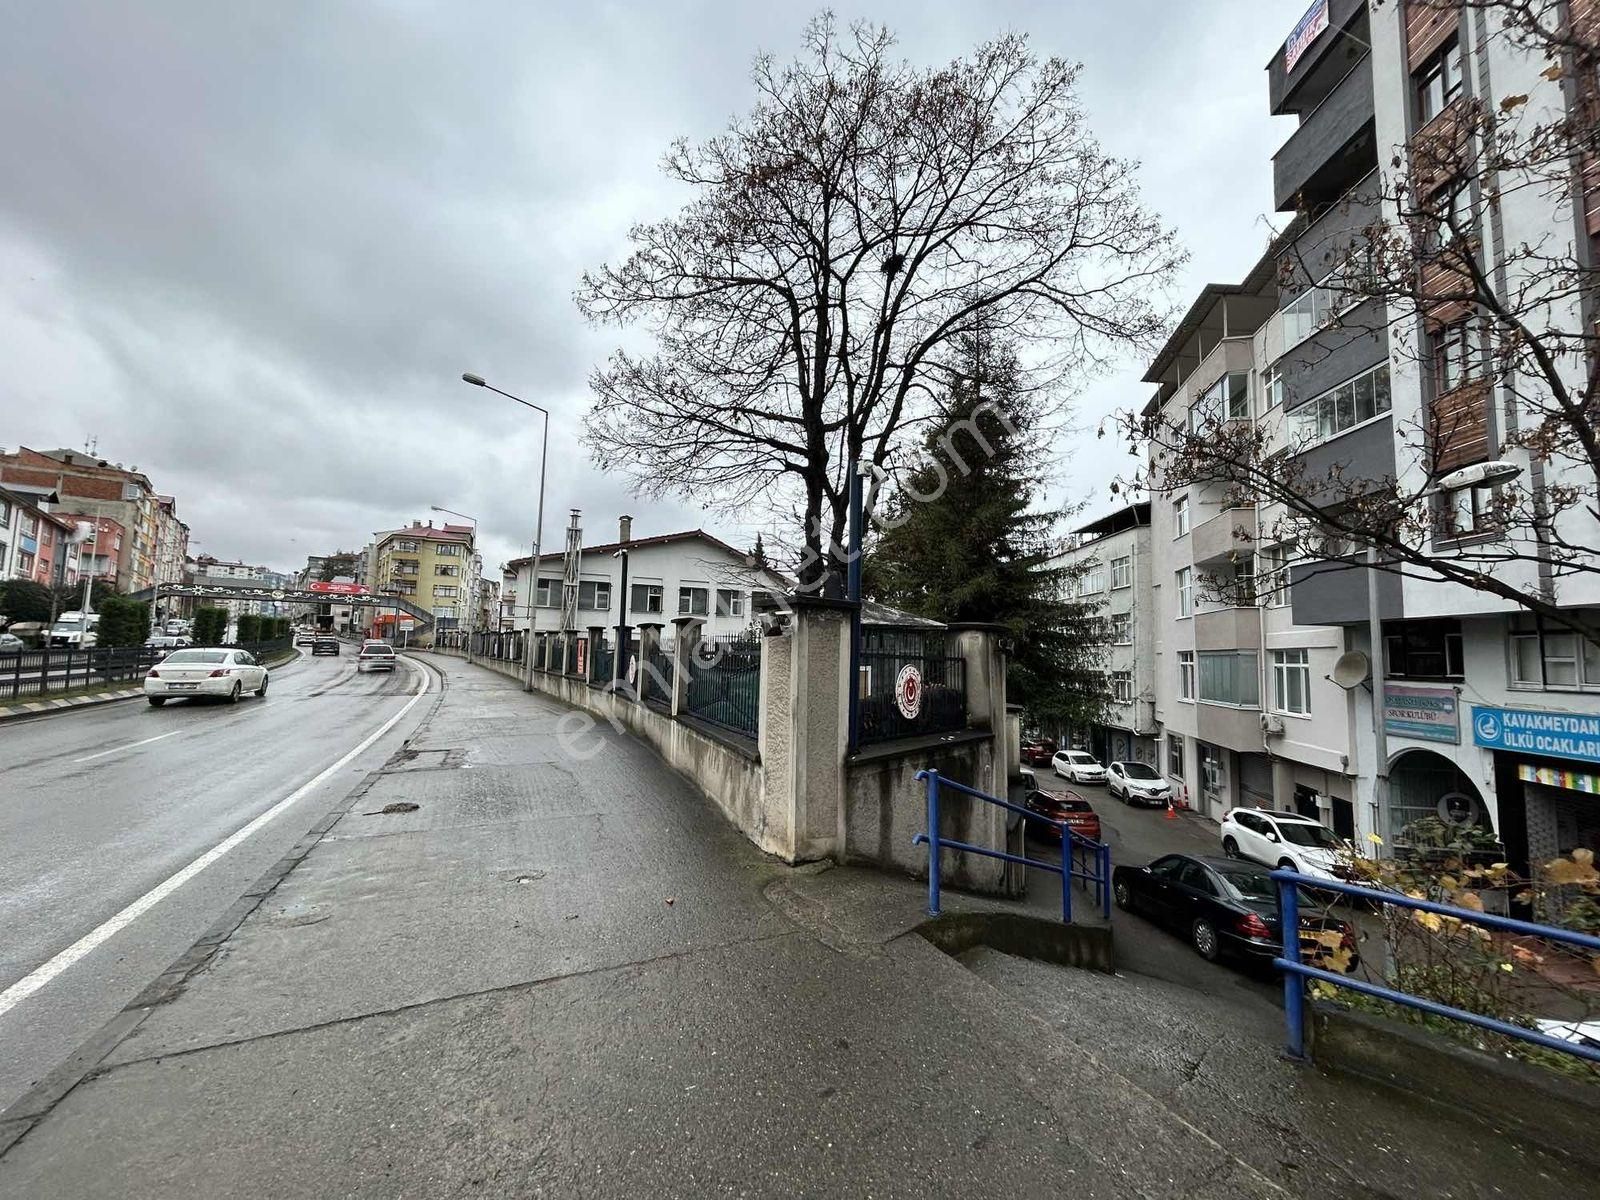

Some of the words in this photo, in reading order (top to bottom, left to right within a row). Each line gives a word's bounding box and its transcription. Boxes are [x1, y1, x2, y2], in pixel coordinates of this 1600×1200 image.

[1502, 713, 1599, 735] KAVAKMEYDAN
[1504, 729, 1533, 748] ÜLKÜ
[1536, 735, 1600, 757] OCAKLARI
